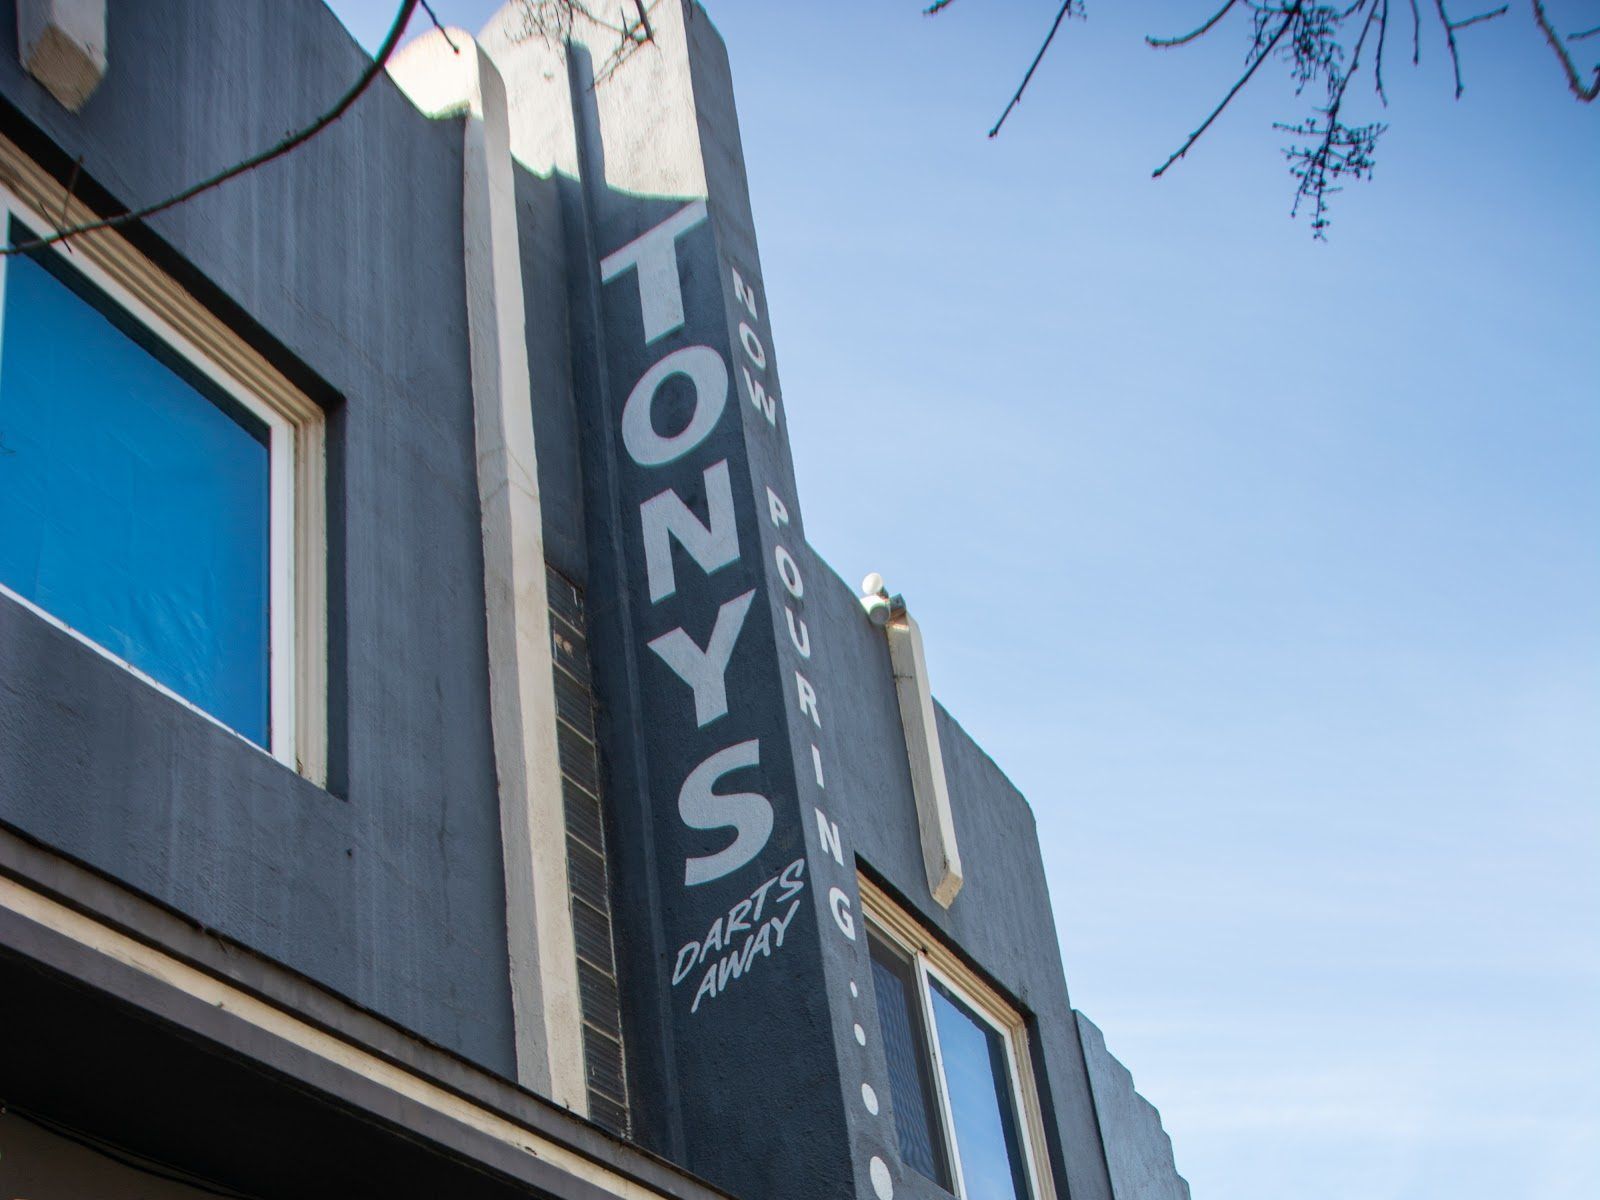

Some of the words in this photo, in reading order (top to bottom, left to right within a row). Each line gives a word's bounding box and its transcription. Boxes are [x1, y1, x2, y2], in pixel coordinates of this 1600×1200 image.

[732, 267, 776, 427] NOW
[601, 200, 775, 887] TONYS
[671, 858, 805, 986] DARTS
[691, 899, 800, 1013] AWAY
